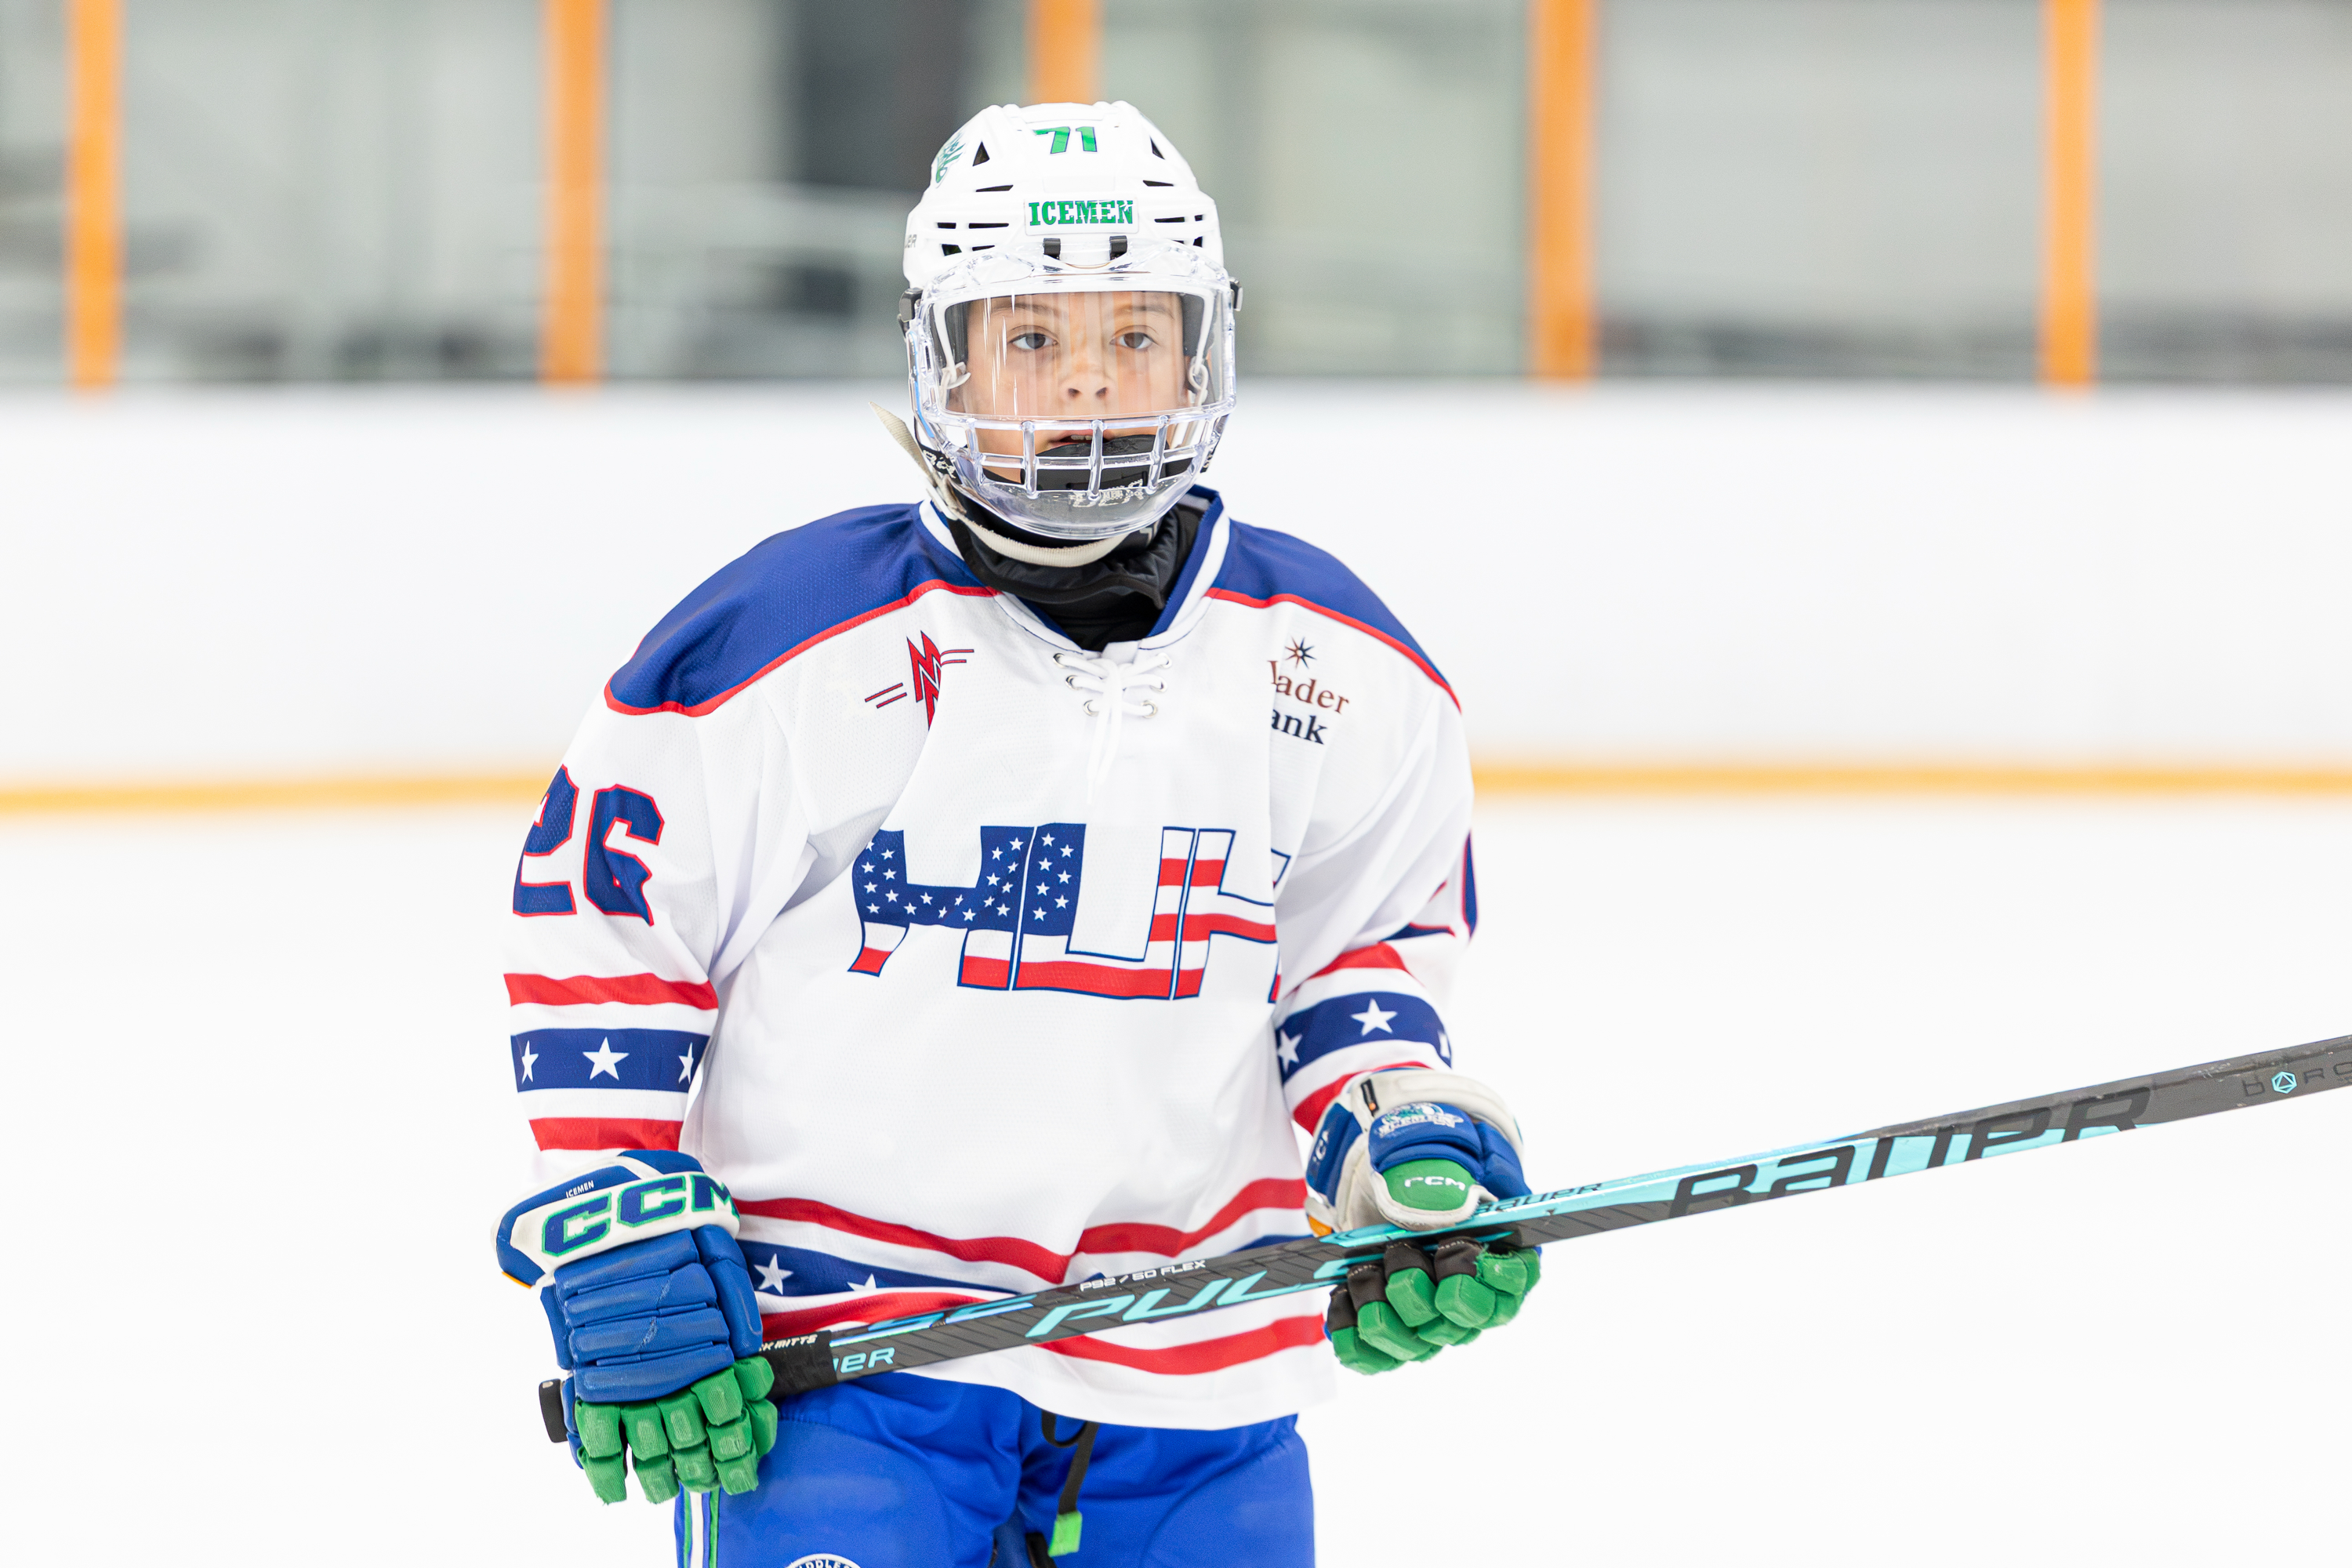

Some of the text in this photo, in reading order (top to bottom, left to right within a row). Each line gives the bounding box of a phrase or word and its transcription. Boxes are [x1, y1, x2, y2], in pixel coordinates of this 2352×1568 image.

[1033, 125, 1098, 154] 71
[1028, 200, 1134, 227] ICEMEN
[513, 764, 666, 927] 26
[565, 1180, 594, 1199] ICEMEN
[542, 1174, 740, 1258] CCM
[1080, 1277, 1116, 1292] P92
[1119, 1275, 1129, 1284] /
[1160, 1259, 1206, 1276] FLEX
[775, 1334, 818, 1349] MITTS
